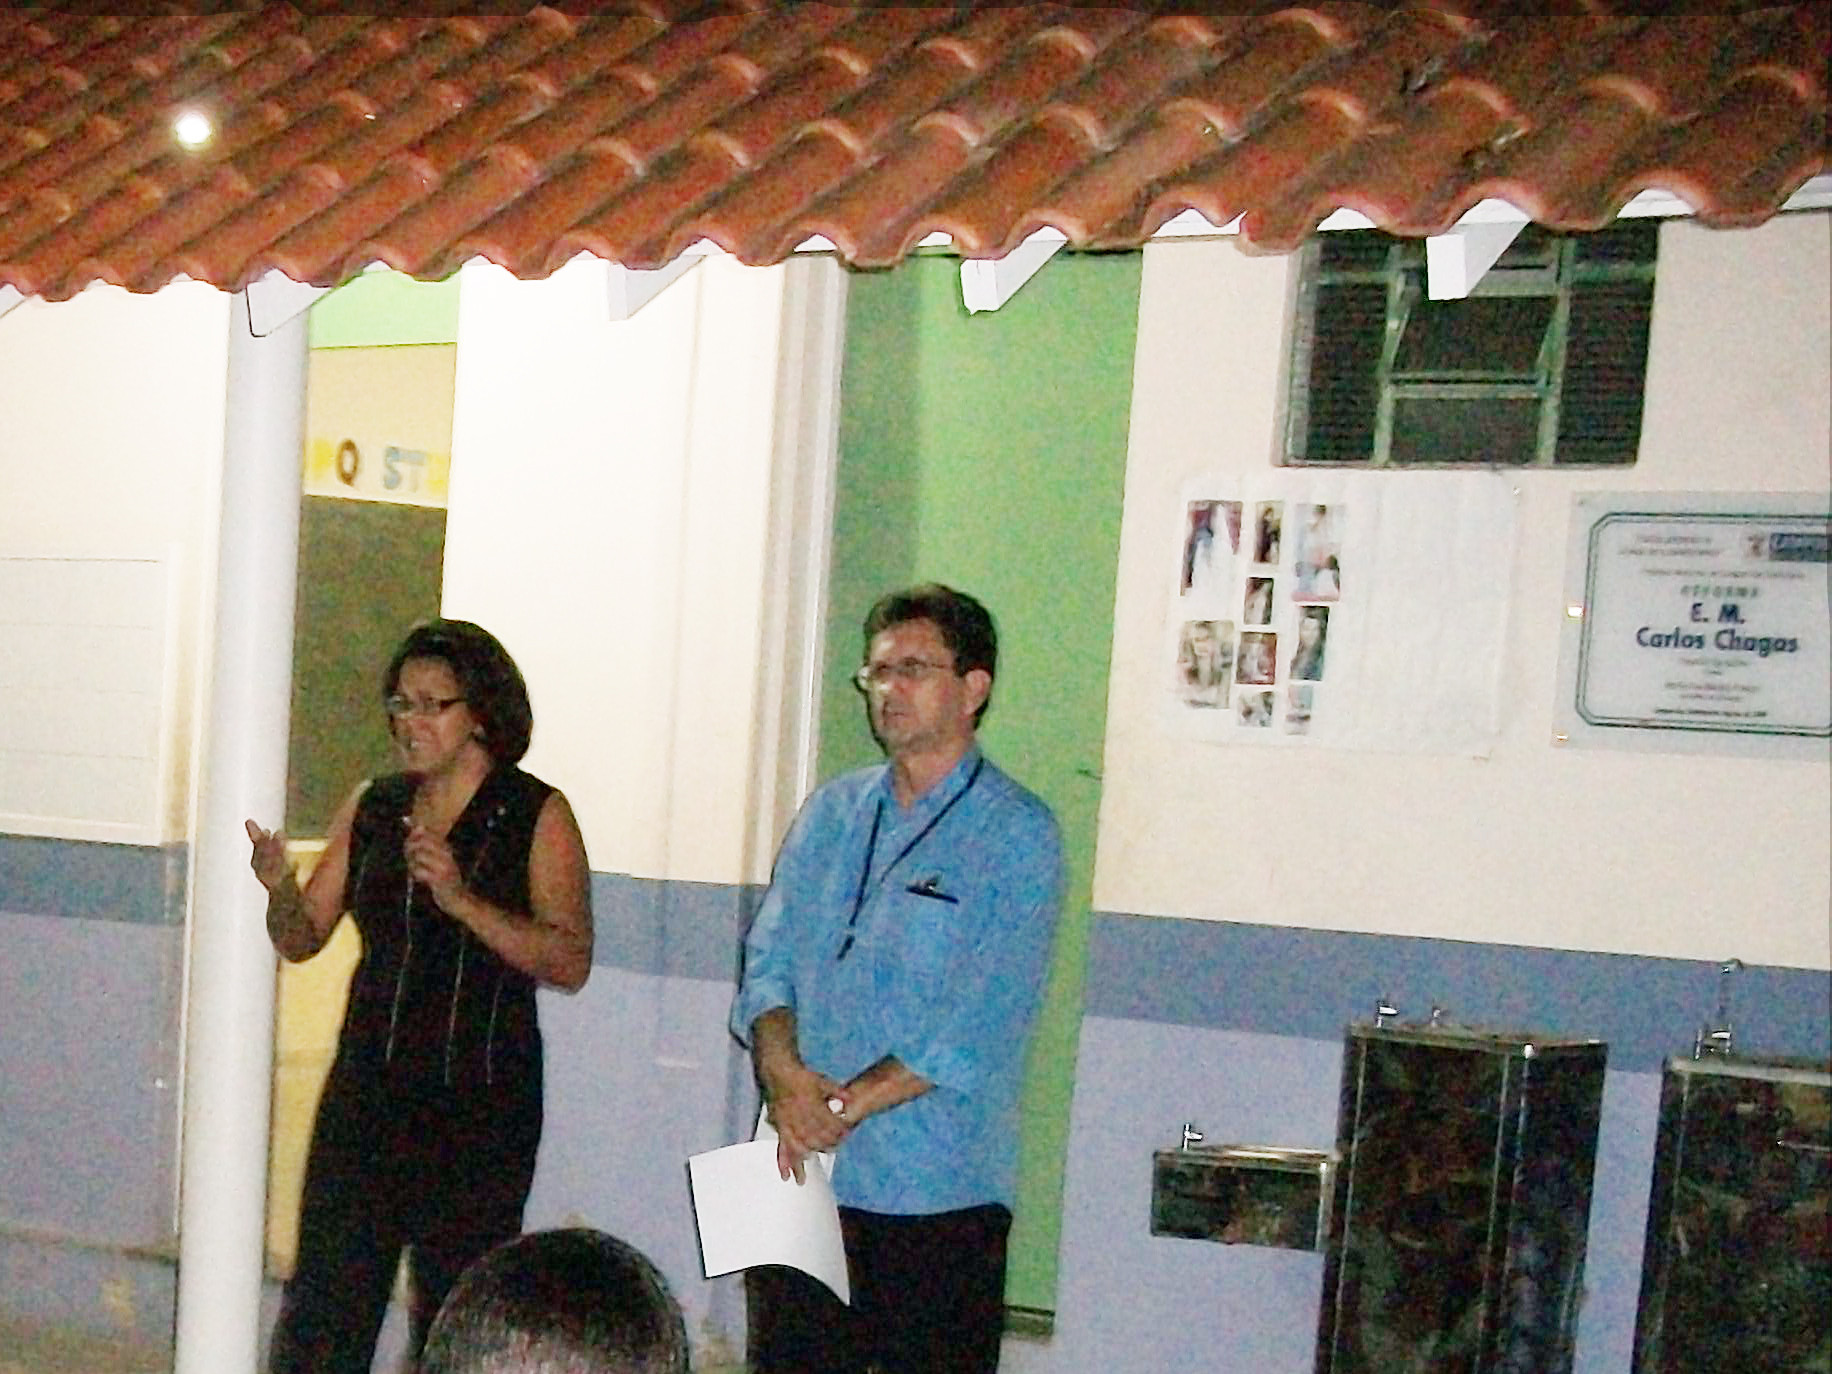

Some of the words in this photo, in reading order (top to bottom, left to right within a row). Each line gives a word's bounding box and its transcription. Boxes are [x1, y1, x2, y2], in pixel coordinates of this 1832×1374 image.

[1690, 602, 1709, 623] E.
[1718, 603, 1746, 625] M.
[1636, 626, 1705, 649] Carlos
[1714, 628, 1799, 658] Chagas
